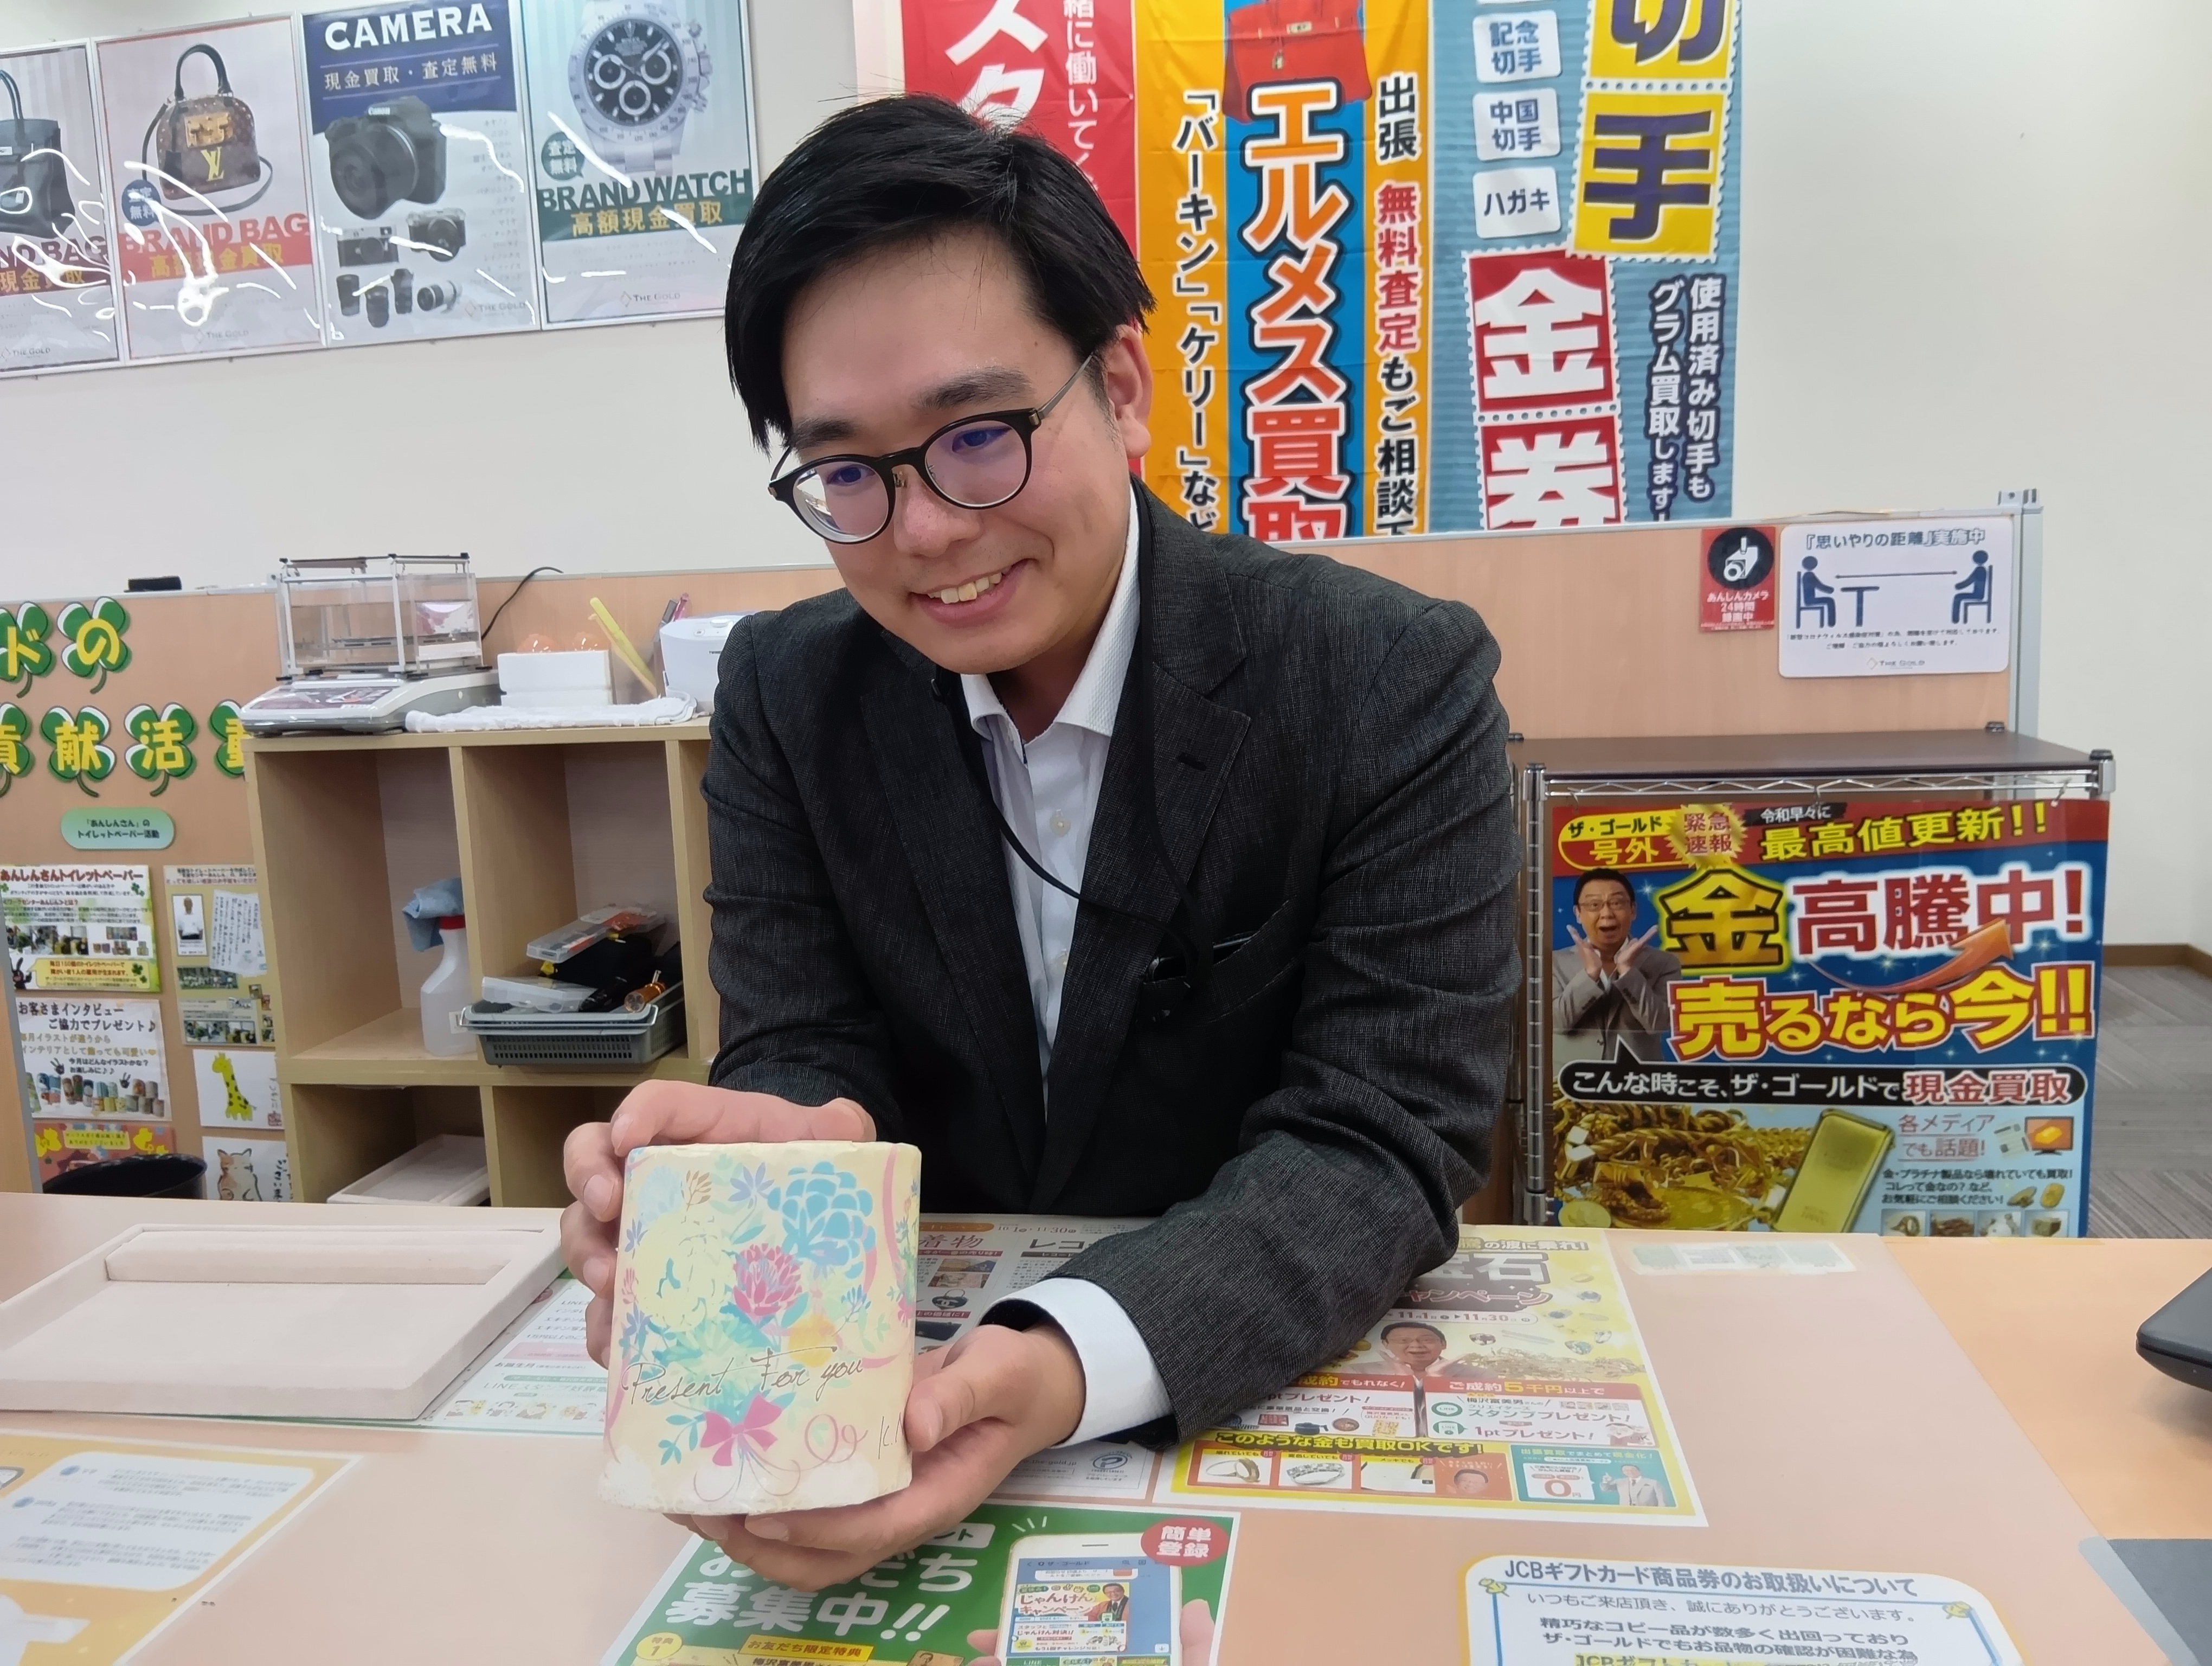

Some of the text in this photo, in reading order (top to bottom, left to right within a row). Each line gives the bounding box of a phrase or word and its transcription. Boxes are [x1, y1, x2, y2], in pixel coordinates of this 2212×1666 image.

[325, 3, 493, 50] CAMERA
[1489, 20, 1539, 47] 記念
[324, 52, 497, 92] 現金買取・査定無料
[1491, 48, 1542, 75] 切手
[1378, 76, 1417, 161] 出張
[1490, 98, 1539, 124] 中国
[1492, 126, 1541, 151] 切手
[549, 156, 577, 175] 無料
[540, 168, 752, 212] BRAND WATCH
[1483, 188, 1550, 216] ハガキ
[239, 213, 310, 244] BAG
[571, 200, 723, 238] 高額現金買取
[41, 235, 112, 266] BAG
[1684, 278, 1724, 498] 使用済み切手も
[1707, 590, 1769, 603] あんしんカメラ
[7, 617, 120, 677] ドの
[1568, 816, 1663, 838] ザ・ゴールド
[1684, 811, 1731, 831] 緊急
[1760, 806, 1832, 824] 令和早々に
[1760, 802, 2047, 861] 最高値更新!!
[1590, 836, 1660, 864] 号外
[1686, 835, 1733, 855] 速報
[18, 1002, 124, 1016] お客さまインタビュー
[1675, 965, 2088, 1056] 売るなら今!!
[1572, 1071, 2070, 1104] こんな時こそ、ザ・ゴールドで現金買取
[1898, 1113, 1995, 1133] 各メディア
[1902, 1138, 1986, 1158] でも話題!
[919, 1234, 984, 1248] 着物
[1029, 1238, 1091, 1250] レコ
[621, 1347, 863, 1405] Present For you
[1217, 1432, 1483, 1454] このような金も買取OKです!
[1474, 1426, 1594, 1440] 1ptプレゼント!
[1160, 1526, 1211, 1542] 簡単
[1156, 1541, 1210, 1559] 登録
[1505, 1559, 1919, 1597] JCBギフトカード商品券のお取扱いについて
[665, 1581, 950, 1642] 募集中!!
[1020, 1593, 1093, 1605] じゃんけん
[1020, 1605, 1091, 1614] キャンペーン
[1540, 1616, 1909, 1645] 精巧なコピー品が数多く出回っており
[650, 1645, 659, 1657] 1
[748, 1639, 862, 1658] お友だち限定特典
[1542, 1632, 1919, 1663] ザ・ゴールドでもお品物の確認が困難な為
